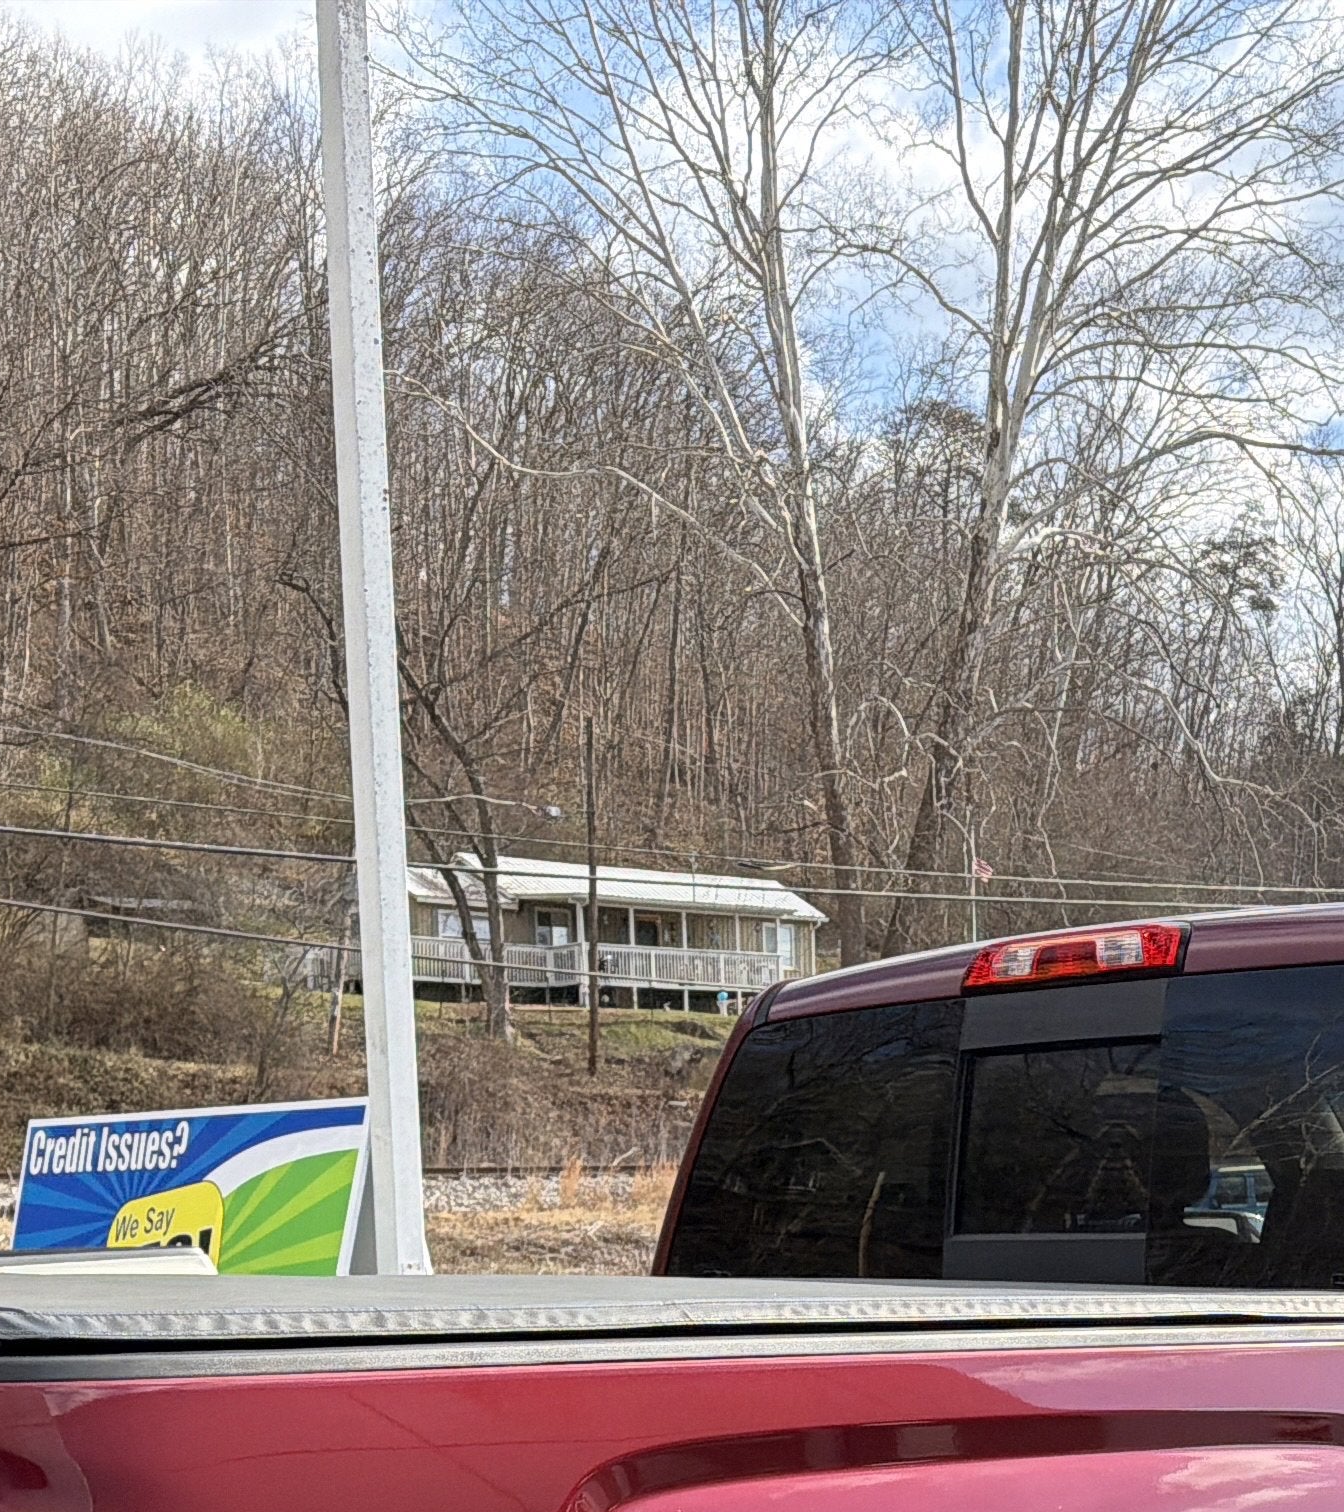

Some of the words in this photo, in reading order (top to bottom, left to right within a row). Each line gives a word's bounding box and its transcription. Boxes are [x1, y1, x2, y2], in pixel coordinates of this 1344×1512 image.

[29, 1128, 96, 1175] Credit
[97, 1120, 190, 1172] Issues?
[115, 1214, 140, 1243] We
[144, 1206, 175, 1237] Say
